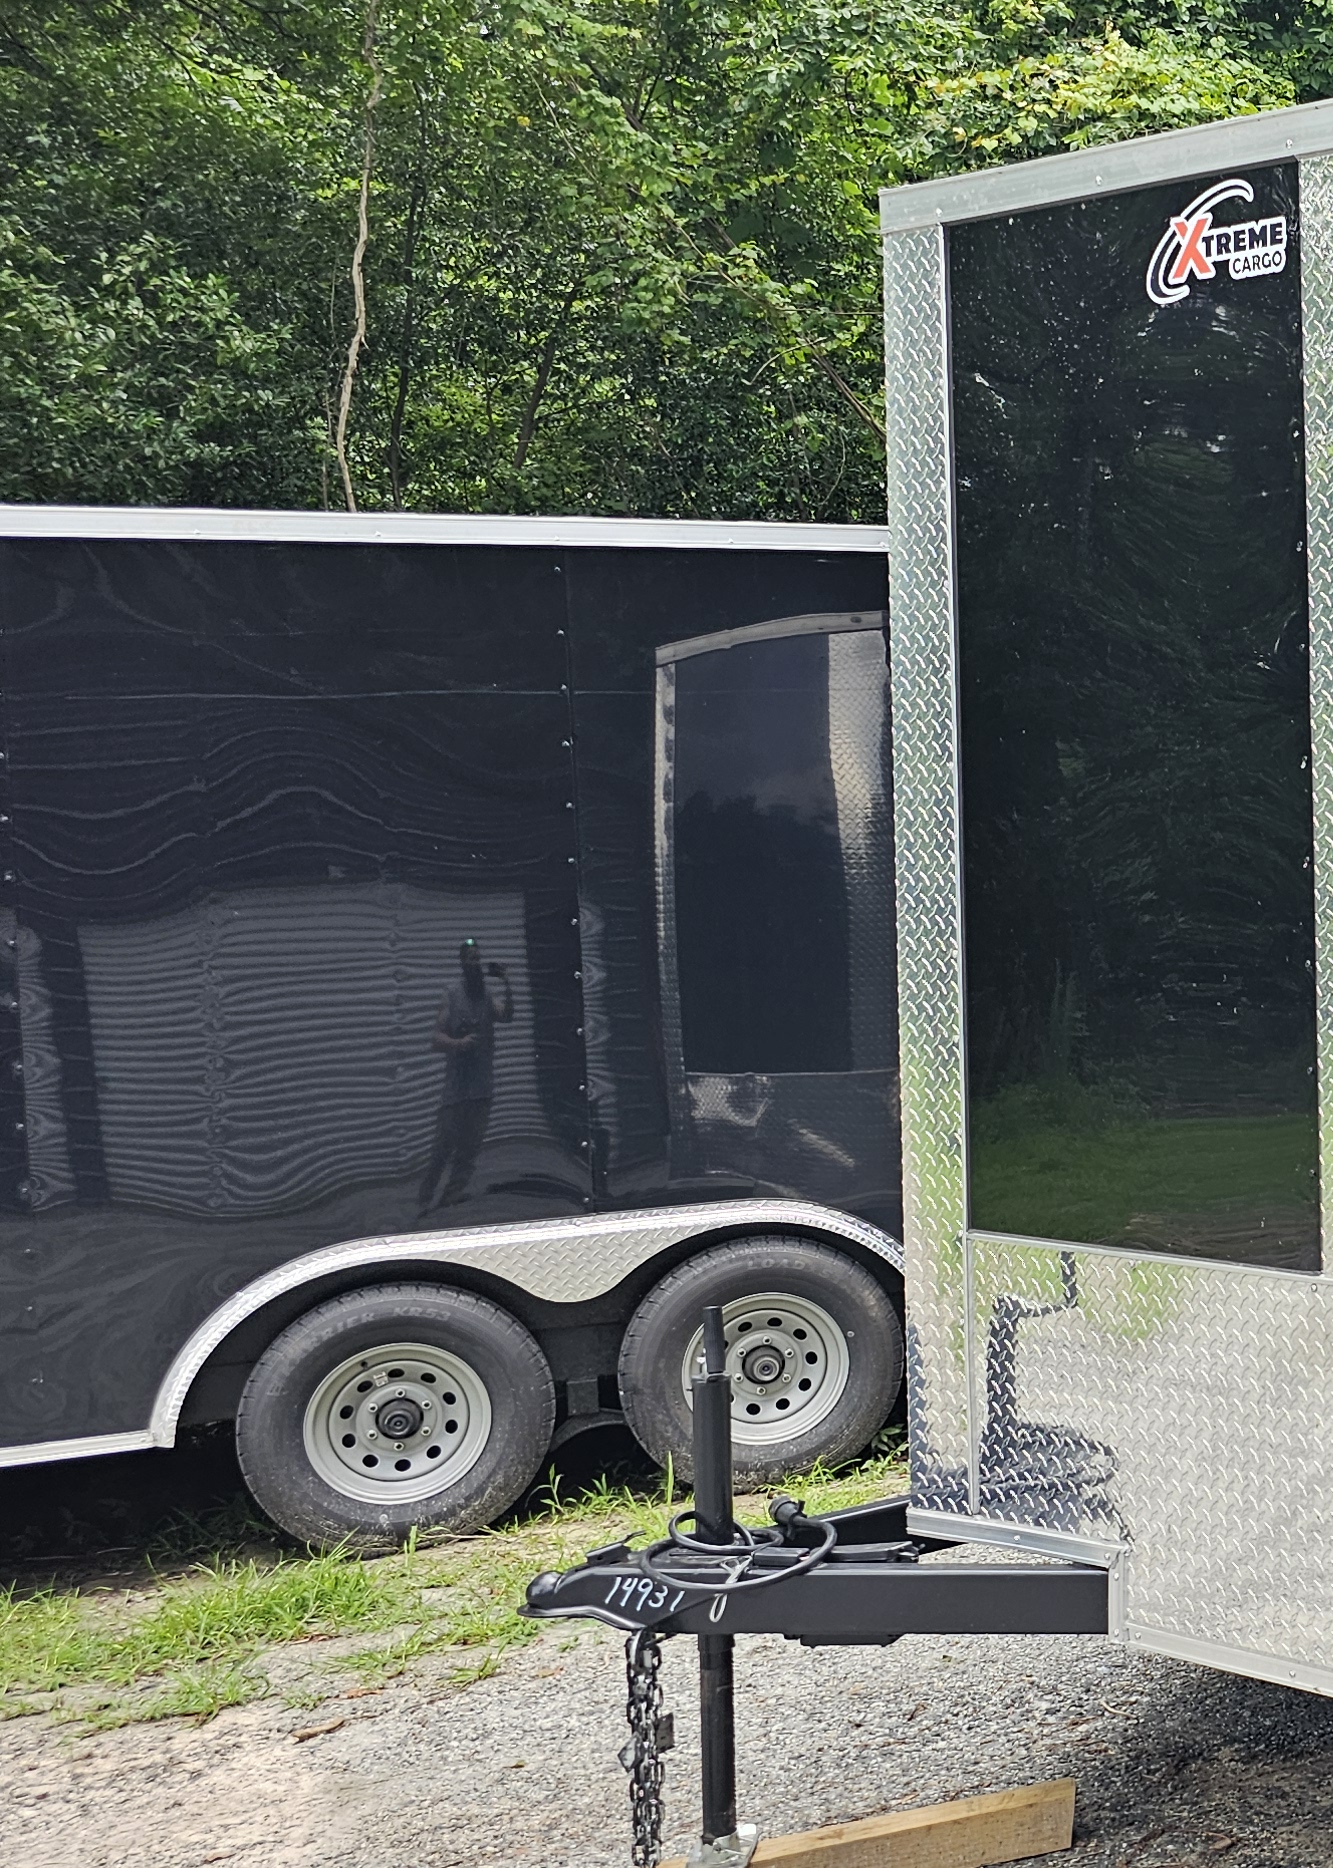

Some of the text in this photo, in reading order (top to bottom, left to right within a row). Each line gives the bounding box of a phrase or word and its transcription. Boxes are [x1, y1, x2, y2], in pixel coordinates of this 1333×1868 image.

[1171, 217, 1284, 280] XTREME
[1232, 252, 1283, 274] CARGO
[604, 1576, 685, 1612] 14931
